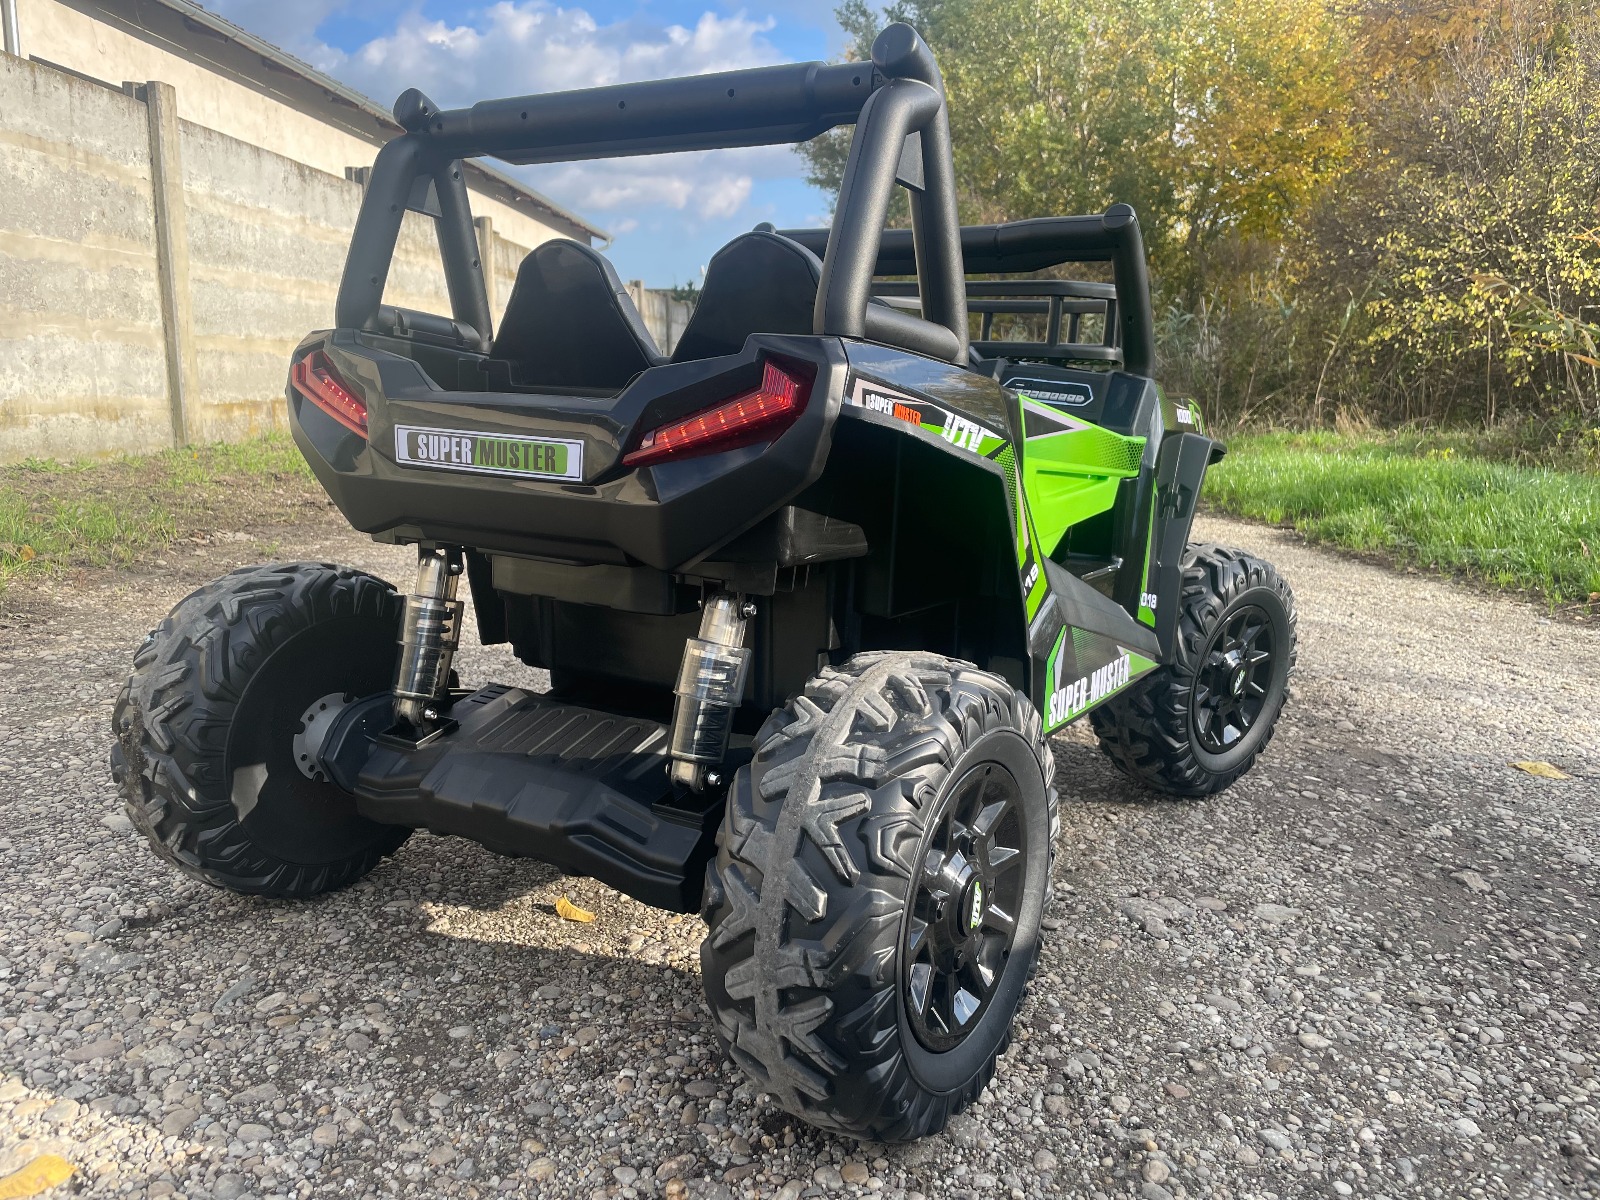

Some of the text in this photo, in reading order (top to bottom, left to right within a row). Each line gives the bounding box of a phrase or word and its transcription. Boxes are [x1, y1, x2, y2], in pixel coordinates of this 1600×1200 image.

[870, 393, 922, 427] SUPER MUSTER
[417, 433, 557, 472] SUPER MUSTER
[1140, 592, 1157, 609] 018
[1048, 653, 1130, 728] SUPER MUSTER
